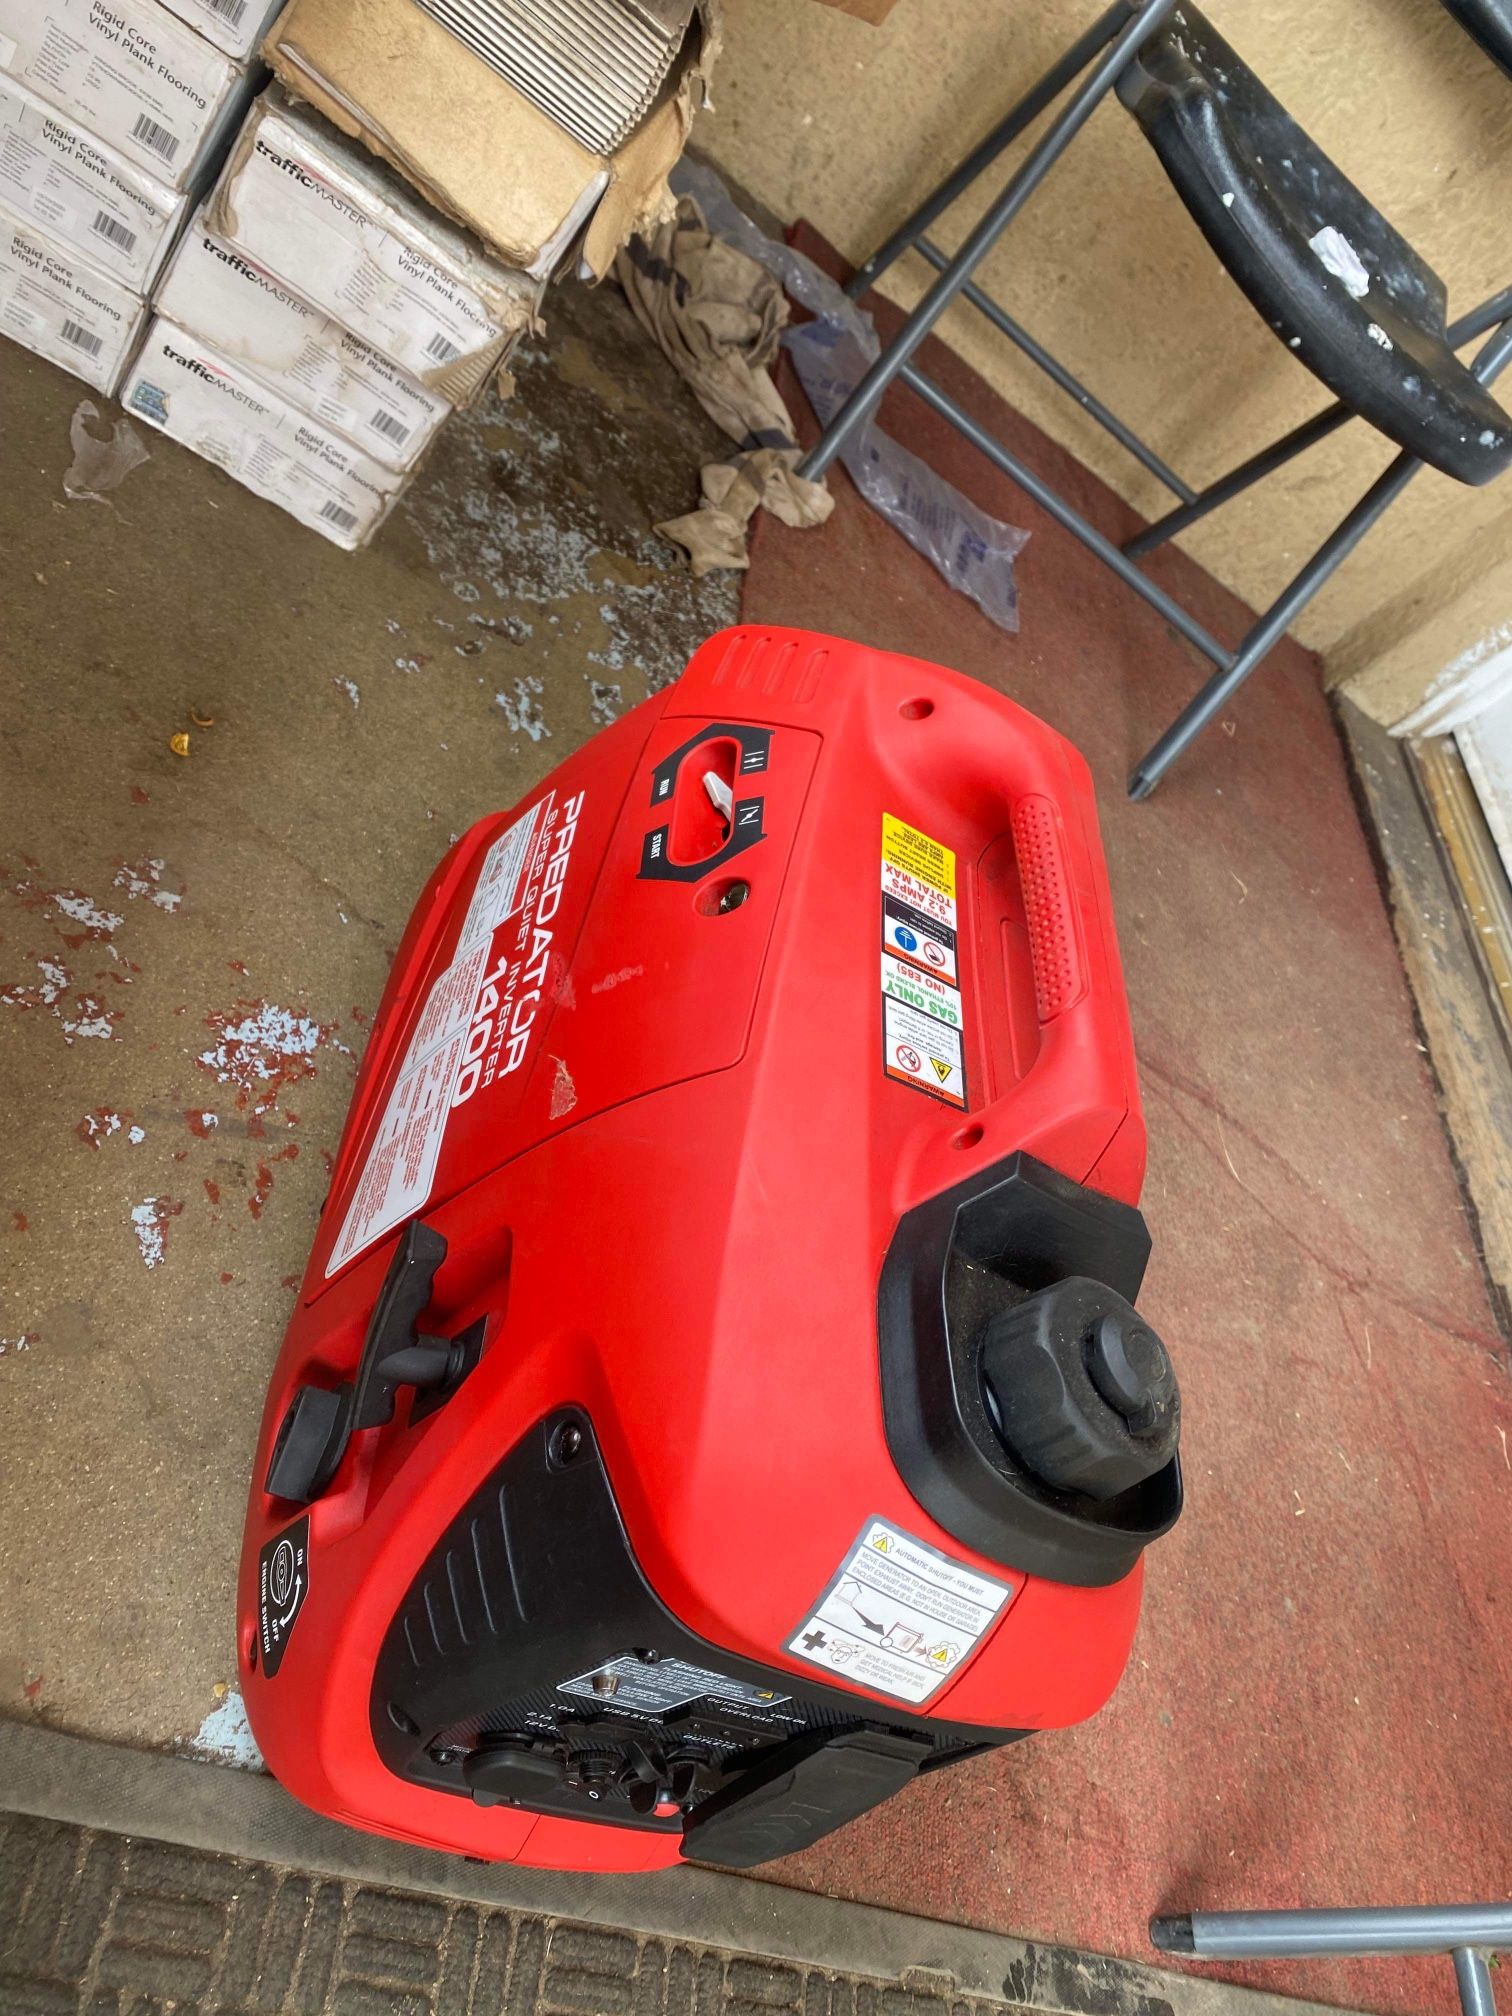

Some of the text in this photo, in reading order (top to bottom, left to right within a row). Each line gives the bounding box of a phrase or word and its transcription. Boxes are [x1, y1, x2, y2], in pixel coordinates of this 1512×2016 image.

[92, 0, 157, 55] Rigid Core
[88, 12, 120, 43] Vinyl
[121, 38, 155, 69] Plank
[158, 65, 207, 110] Flooring
[45, 119, 108, 166] Rigid Core
[42, 128, 73, 155] Vinyl
[75, 151, 107, 178] Plank
[110, 174, 156, 217] Flooring
[13, 236, 73, 278] Rigid Core
[403, 245, 458, 289] Rigid Core
[10, 246, 39, 270] Vinyl
[41, 265, 72, 290] Plank
[75, 285, 121, 321] Flooring
[398, 255, 425, 280] Vinyl
[426, 277, 454, 302] Plank
[345, 333, 397, 372] Rigid Core
[340, 340, 366, 363] Vinyl
[366, 359, 394, 382] Plank
[396, 379, 435, 413] Flooring
[293, 434, 320, 455] Vinyl
[320, 451, 346, 474] Plank
[298, 427, 348, 464] Rigid Core
[659, 778, 670, 796] RUN
[650, 833, 662, 859] START
[886, 864, 910, 884] MAX
[885, 885, 952, 925] YOU MUST NOT EXCEED
[893, 879, 945, 914] 9.2 AMPS
[916, 881, 951, 908] TOTAL
[481, 809, 558, 1089] SUPER QUIET INVERTER
[498, 790, 585, 1078] PREDATOR
[903, 953, 933, 972] WARNING
[897, 963, 945, 994] (NO E85)
[887, 981, 957, 1023] GAS ONLY
[918, 987, 943, 1003] ETHANOL
[451, 956, 508, 1108] 1400
[906, 1076, 939, 1093] WARNING
[296, 1548, 304, 1566] ON
[857, 1559, 875, 1572] POINT
[862, 1552, 879, 1565] MOVE
[879, 1562, 911, 1582] GENERATOR
[896, 1549, 983, 1595] AUTOMATIC SHUTOFF YOU MUST
[261, 1606, 270, 1654] SWITCH
[271, 1618, 279, 1642] OFF
[663, 1667, 701, 1679] FLASHING
[672, 1663, 726, 1678] SHUTOFF
[526, 1711, 552, 1721] 2.1A
[549, 1703, 575, 1713] 1.0A
[603, 1706, 630, 1717] USB
[707, 1697, 750, 1710] OUTPUT
[719, 1707, 774, 1723] OVERLOAD
[770, 1713, 793, 1721] LOW
[524, 1719, 545, 1728] 12V
[683, 1734, 737, 1750] OUTLETS
